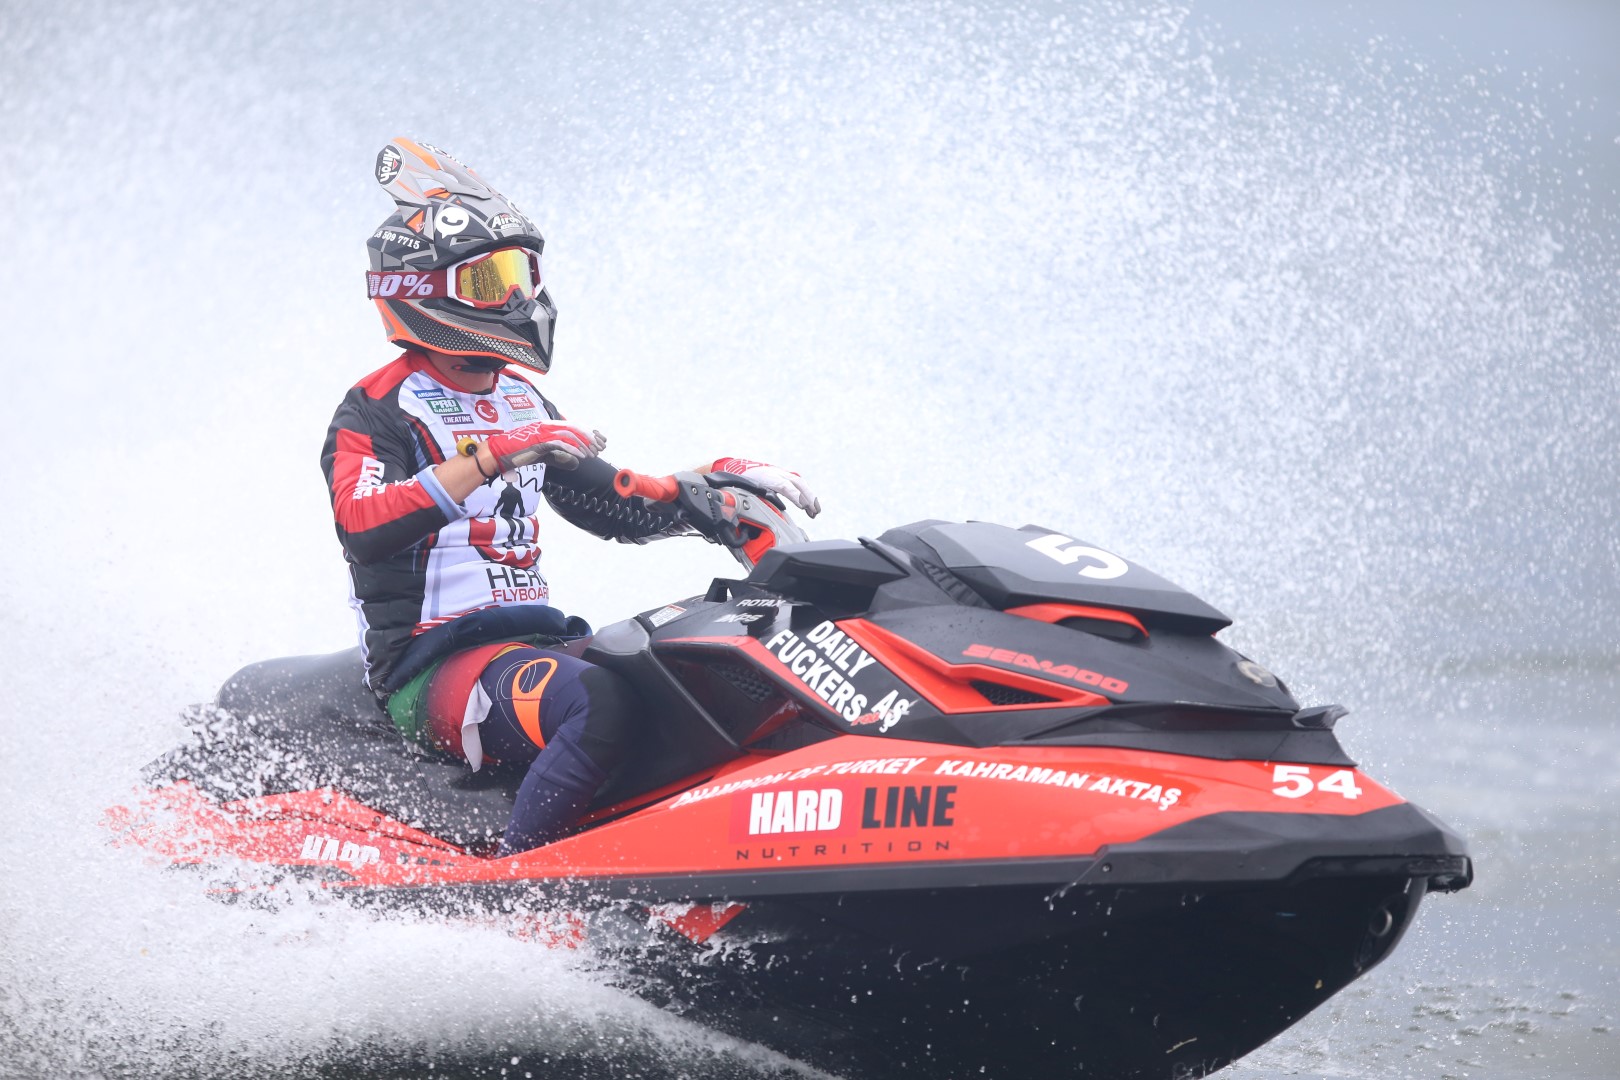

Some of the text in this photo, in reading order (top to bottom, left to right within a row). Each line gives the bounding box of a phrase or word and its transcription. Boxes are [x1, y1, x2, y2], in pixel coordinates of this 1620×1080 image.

[382, 231, 396, 242] 509
[397, 235, 421, 250] 7715
[368, 274, 434, 297] 00%
[430, 399, 457, 409] PRO
[491, 587, 550, 603] FLYBOAR
[736, 598, 787, 608] ROTAX
[765, 629, 868, 722] FUCKERS
[787, 764, 828, 782] OF
[822, 757, 927, 776] TURKEY
[934, 759, 1090, 789] KAHRAMAN
[1088, 776, 1182, 811] AKTAŞ
[1271, 765, 1363, 800] 54
[749, 785, 958, 836] HARD LINE
[736, 840, 950, 860] NUTRITION
